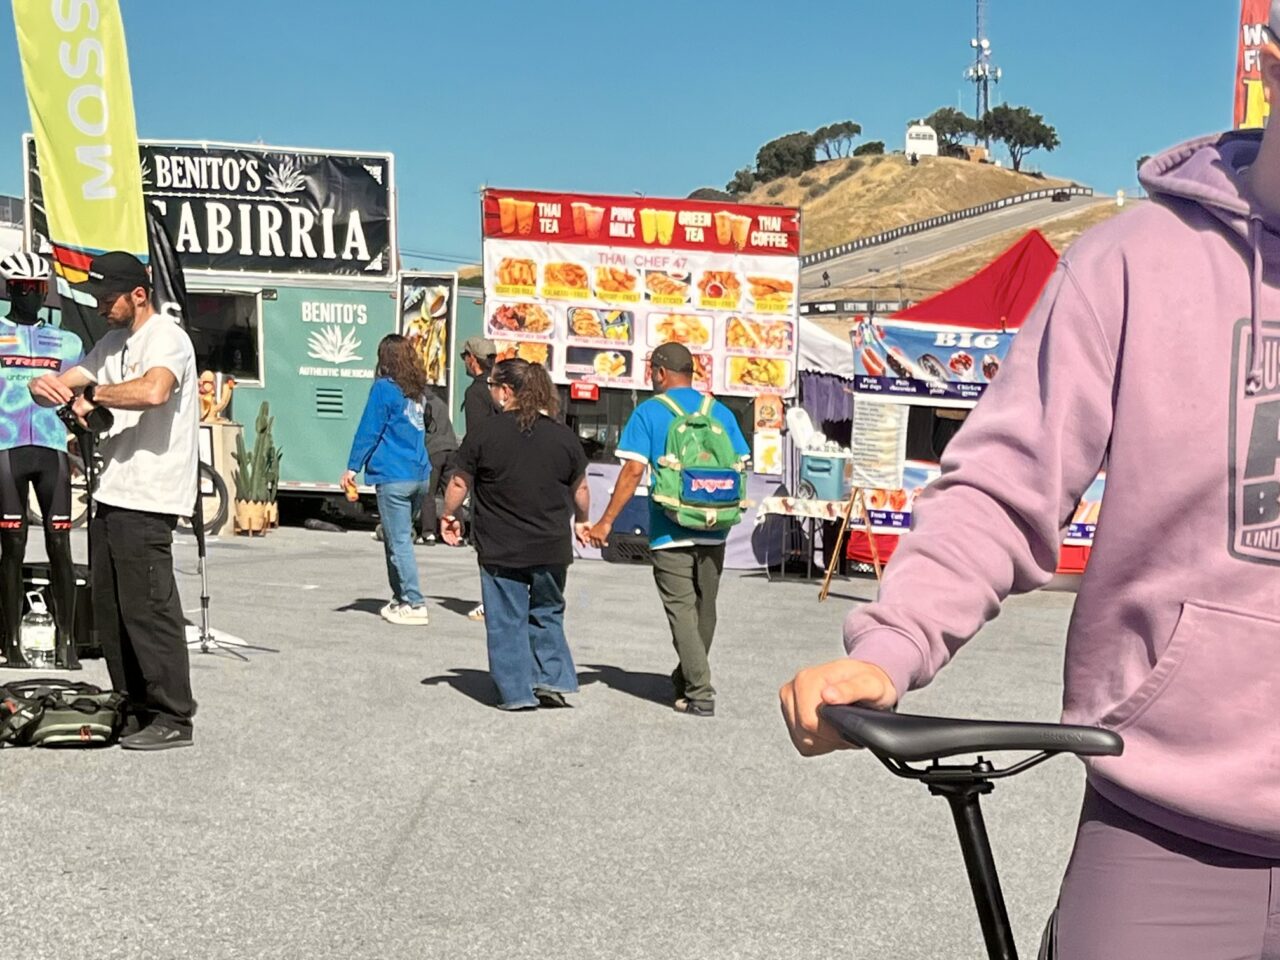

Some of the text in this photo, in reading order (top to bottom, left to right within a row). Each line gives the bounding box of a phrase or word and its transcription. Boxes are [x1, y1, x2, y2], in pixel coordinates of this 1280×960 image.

[154, 155, 262, 192] BENITO'S
[538, 202, 562, 218] THAI
[611, 206, 635, 222] PINK
[539, 218, 559, 234] TEA
[678, 210, 712, 227] GREEN
[758, 215, 781, 232] THAI
[152, 200, 371, 261] ABIRRIA
[609, 222, 635, 238] MILK
[685, 227, 705, 243] TEA
[751, 231, 788, 248] COFFEE
[598, 252, 688, 268] THAI CHEF 47
[302, 302, 368, 324] BENITO'S
[933, 332, 1000, 349] BIG
[3, 356, 60, 369] TREK
[299, 366, 374, 379] AUTHENTIC MEXICAN
